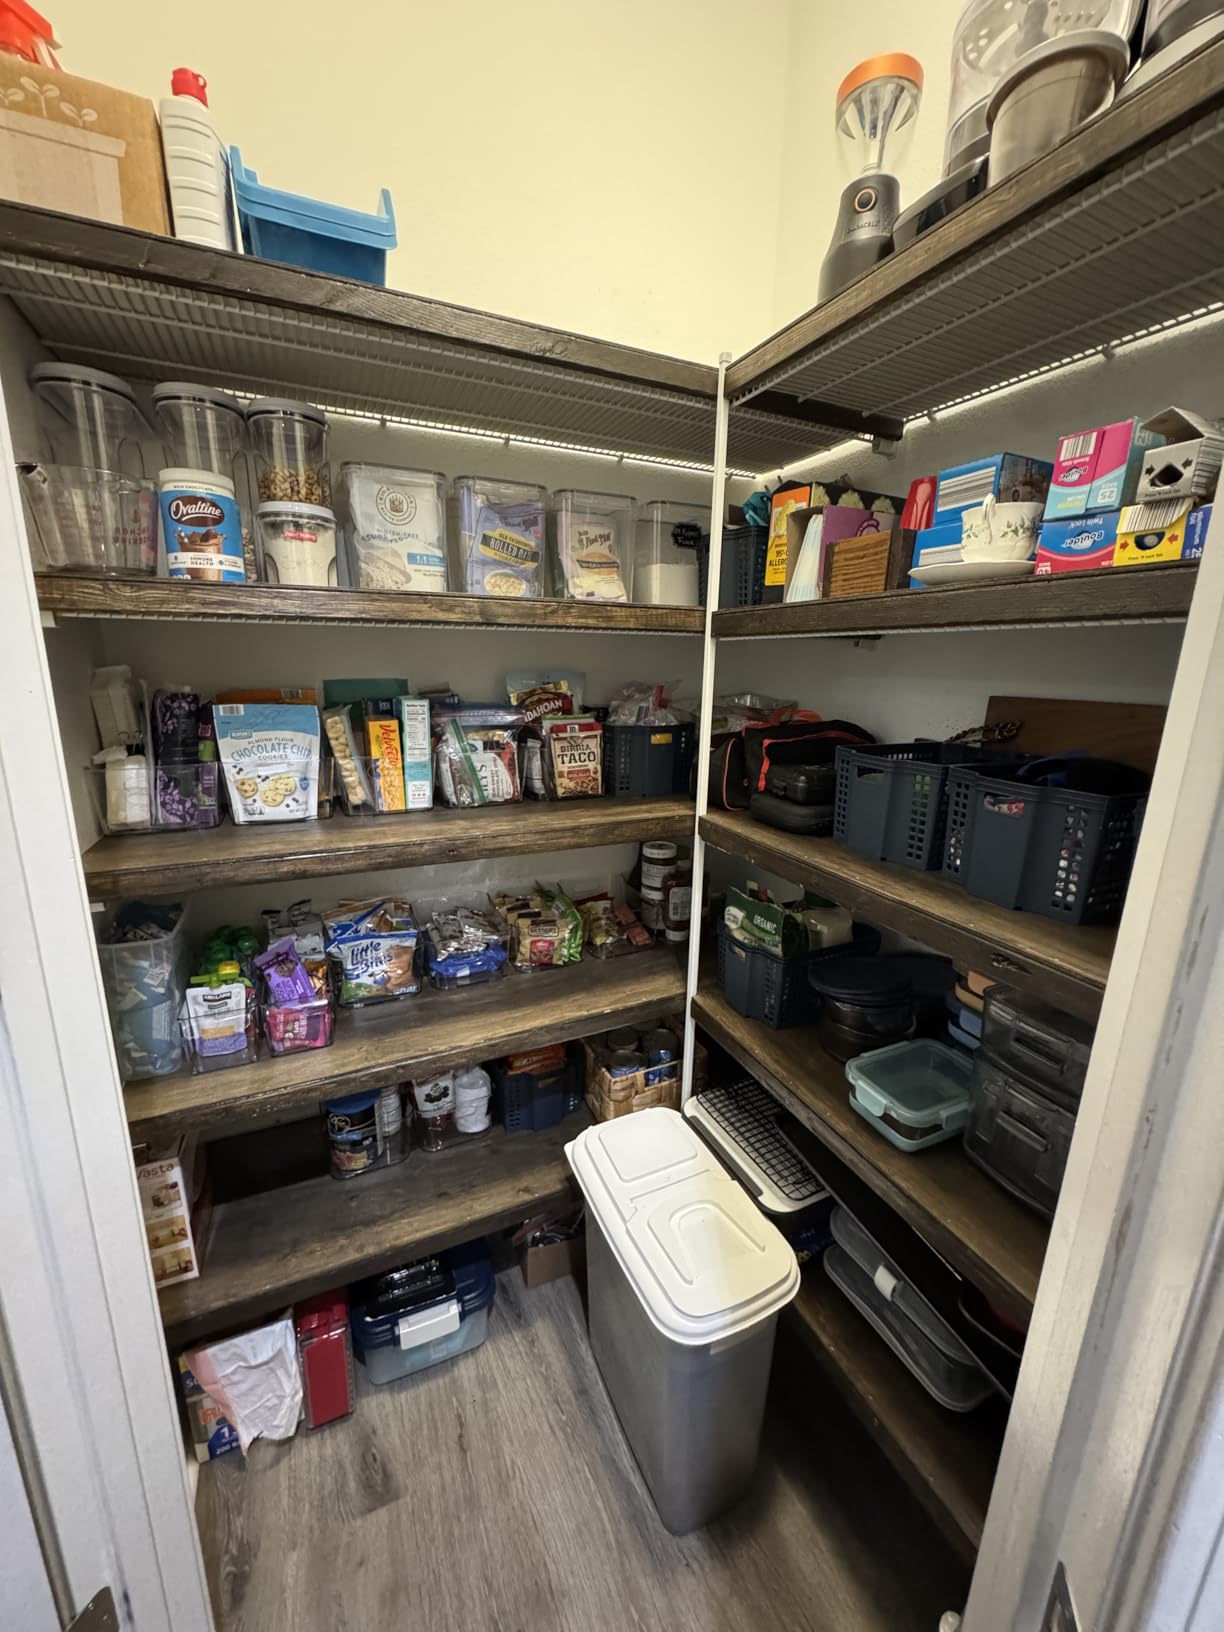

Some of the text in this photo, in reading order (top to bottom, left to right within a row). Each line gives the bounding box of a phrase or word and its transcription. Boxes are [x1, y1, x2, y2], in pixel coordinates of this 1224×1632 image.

[1100, 490, 1116, 501] 25
[170, 500, 222, 521] Ovaltine
[1088, 516, 1104, 526] Twin
[489, 537, 518, 557] ROLLED
[1062, 529, 1105, 548] Boulder
[524, 699, 563, 722] IDAHOAN
[231, 742, 313, 761] CHOCOLATE CHIP
[560, 743, 592, 753] BIRRIA
[557, 751, 596, 765] TACO
[753, 914, 777, 934] ORGANIC
[351, 941, 382, 967] Little
